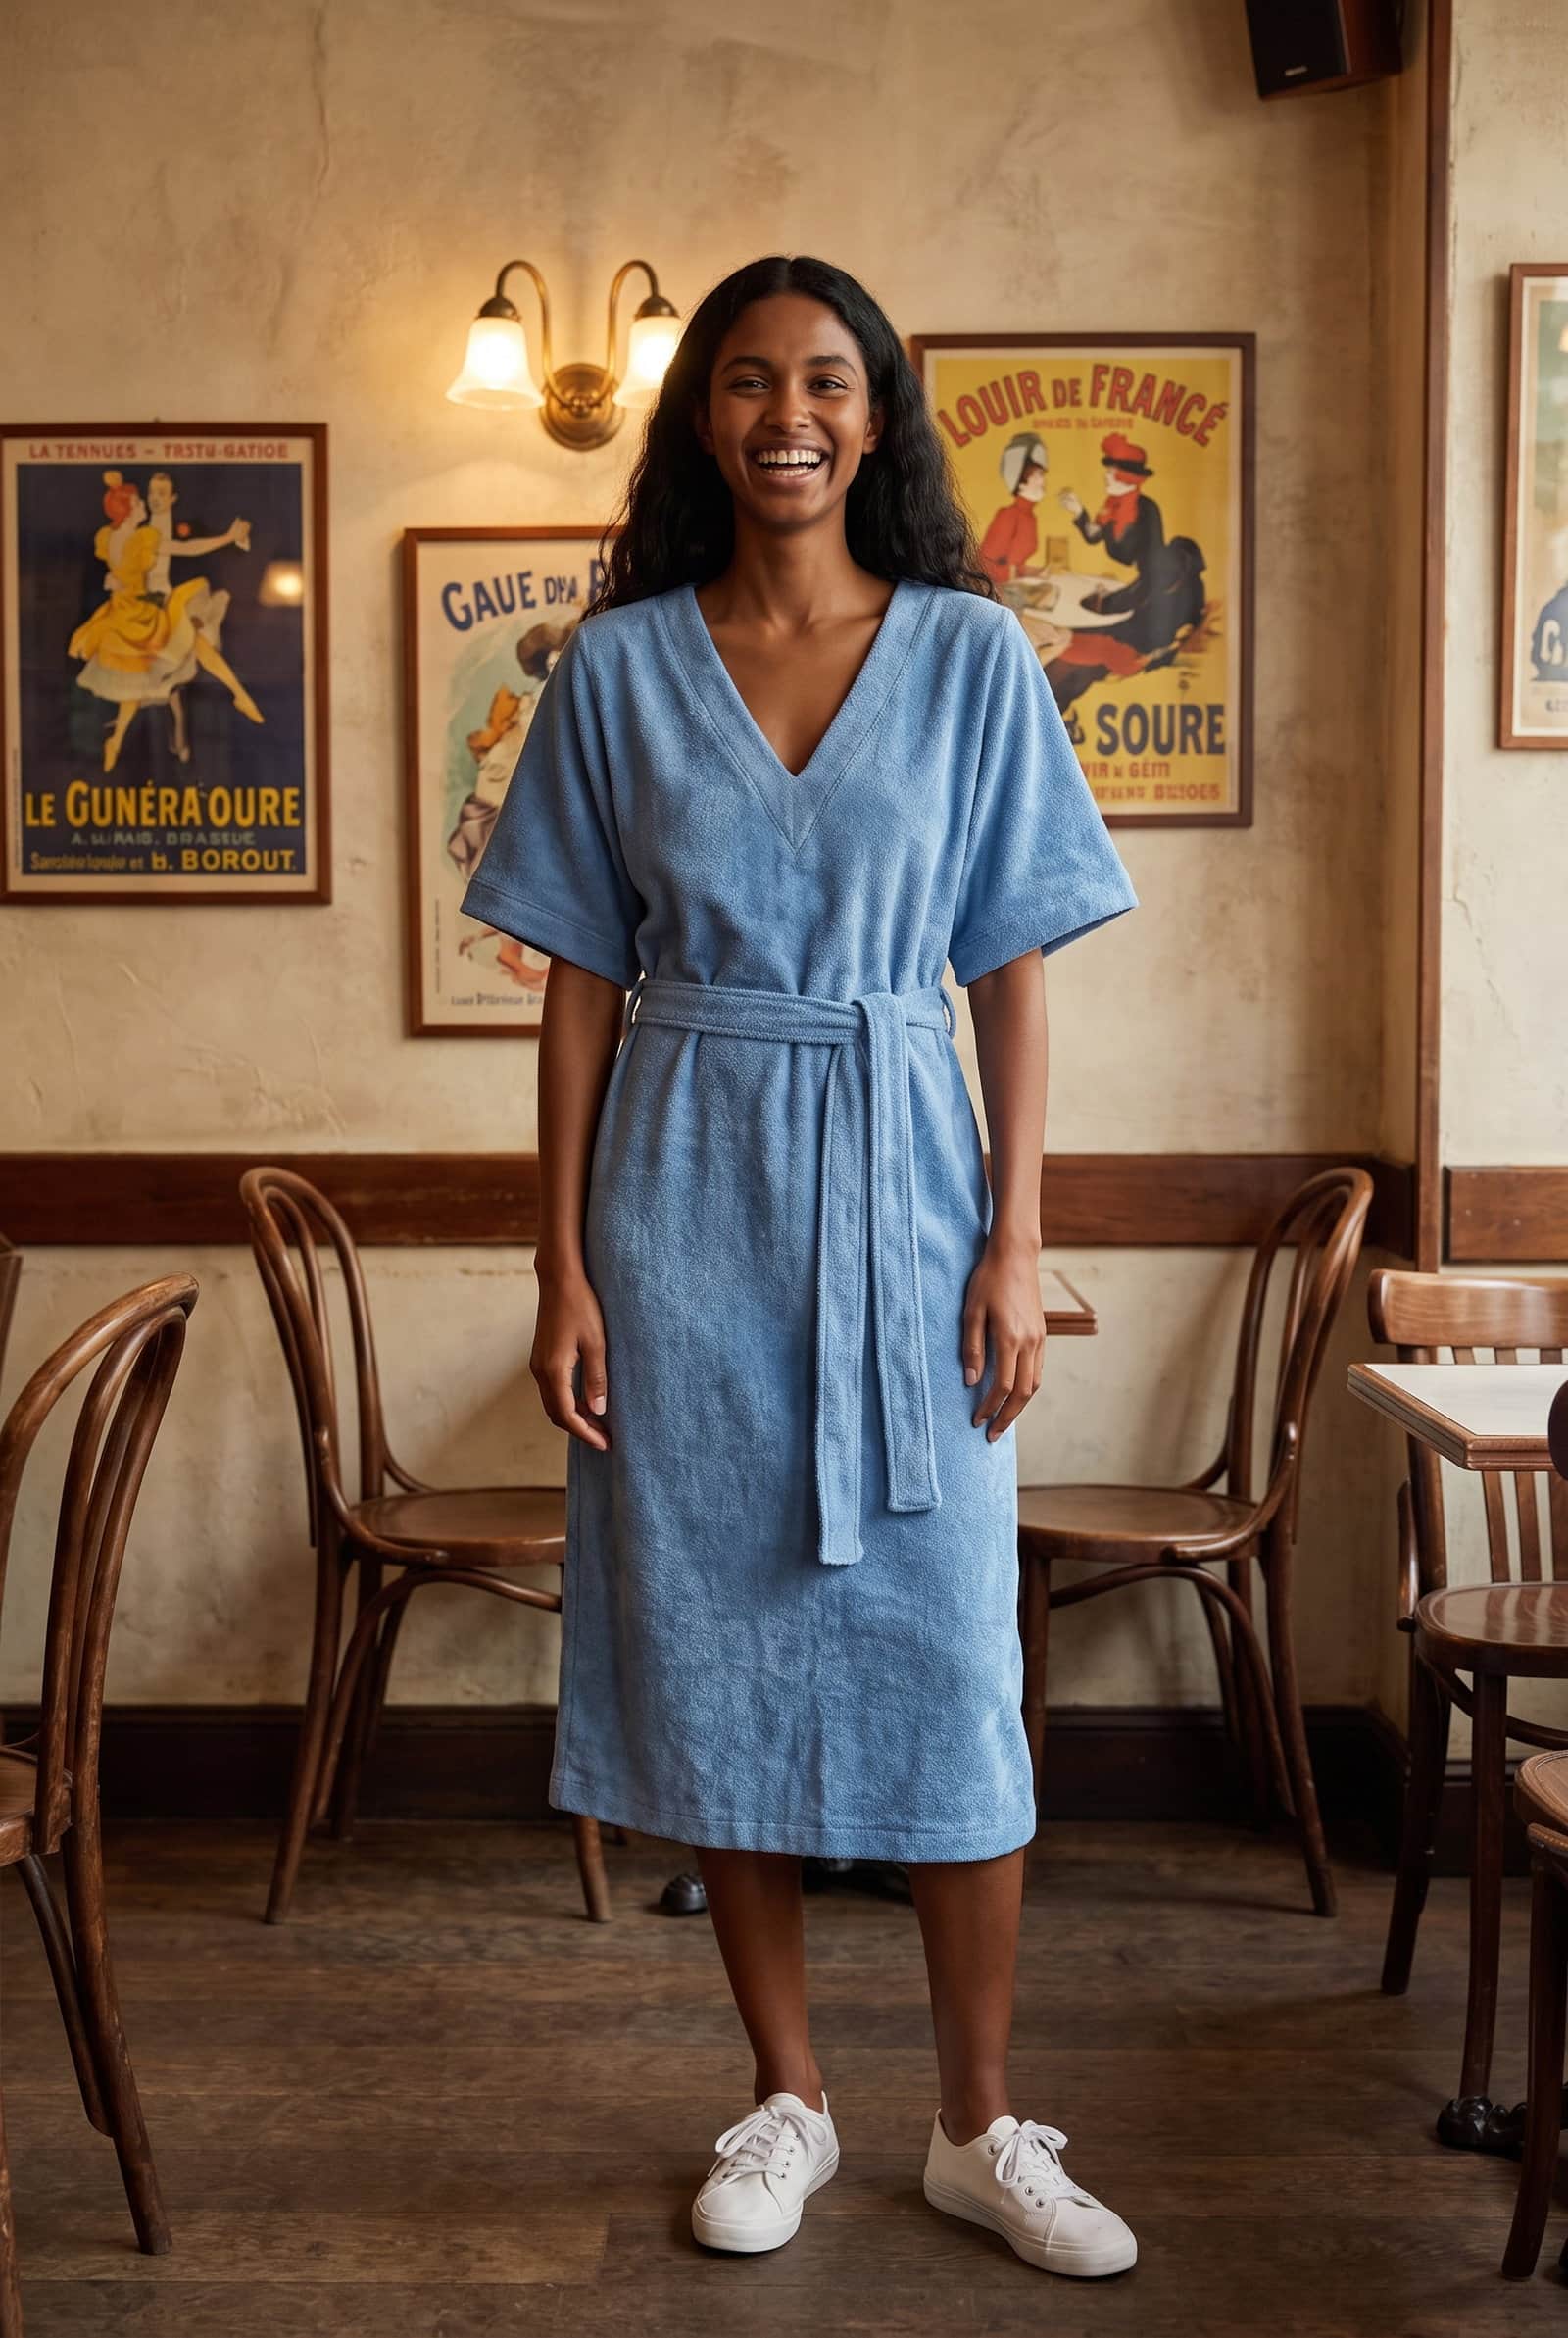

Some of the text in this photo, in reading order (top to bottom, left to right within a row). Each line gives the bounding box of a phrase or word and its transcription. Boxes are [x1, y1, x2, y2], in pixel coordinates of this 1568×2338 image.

[938, 363, 1230, 448] LOUIR DE FRANCÉ
[29, 443, 49, 459] LA
[441, 571, 537, 632] GAUE
[1096, 703, 1225, 756] SOURE
[24, 792, 56, 828] LE
